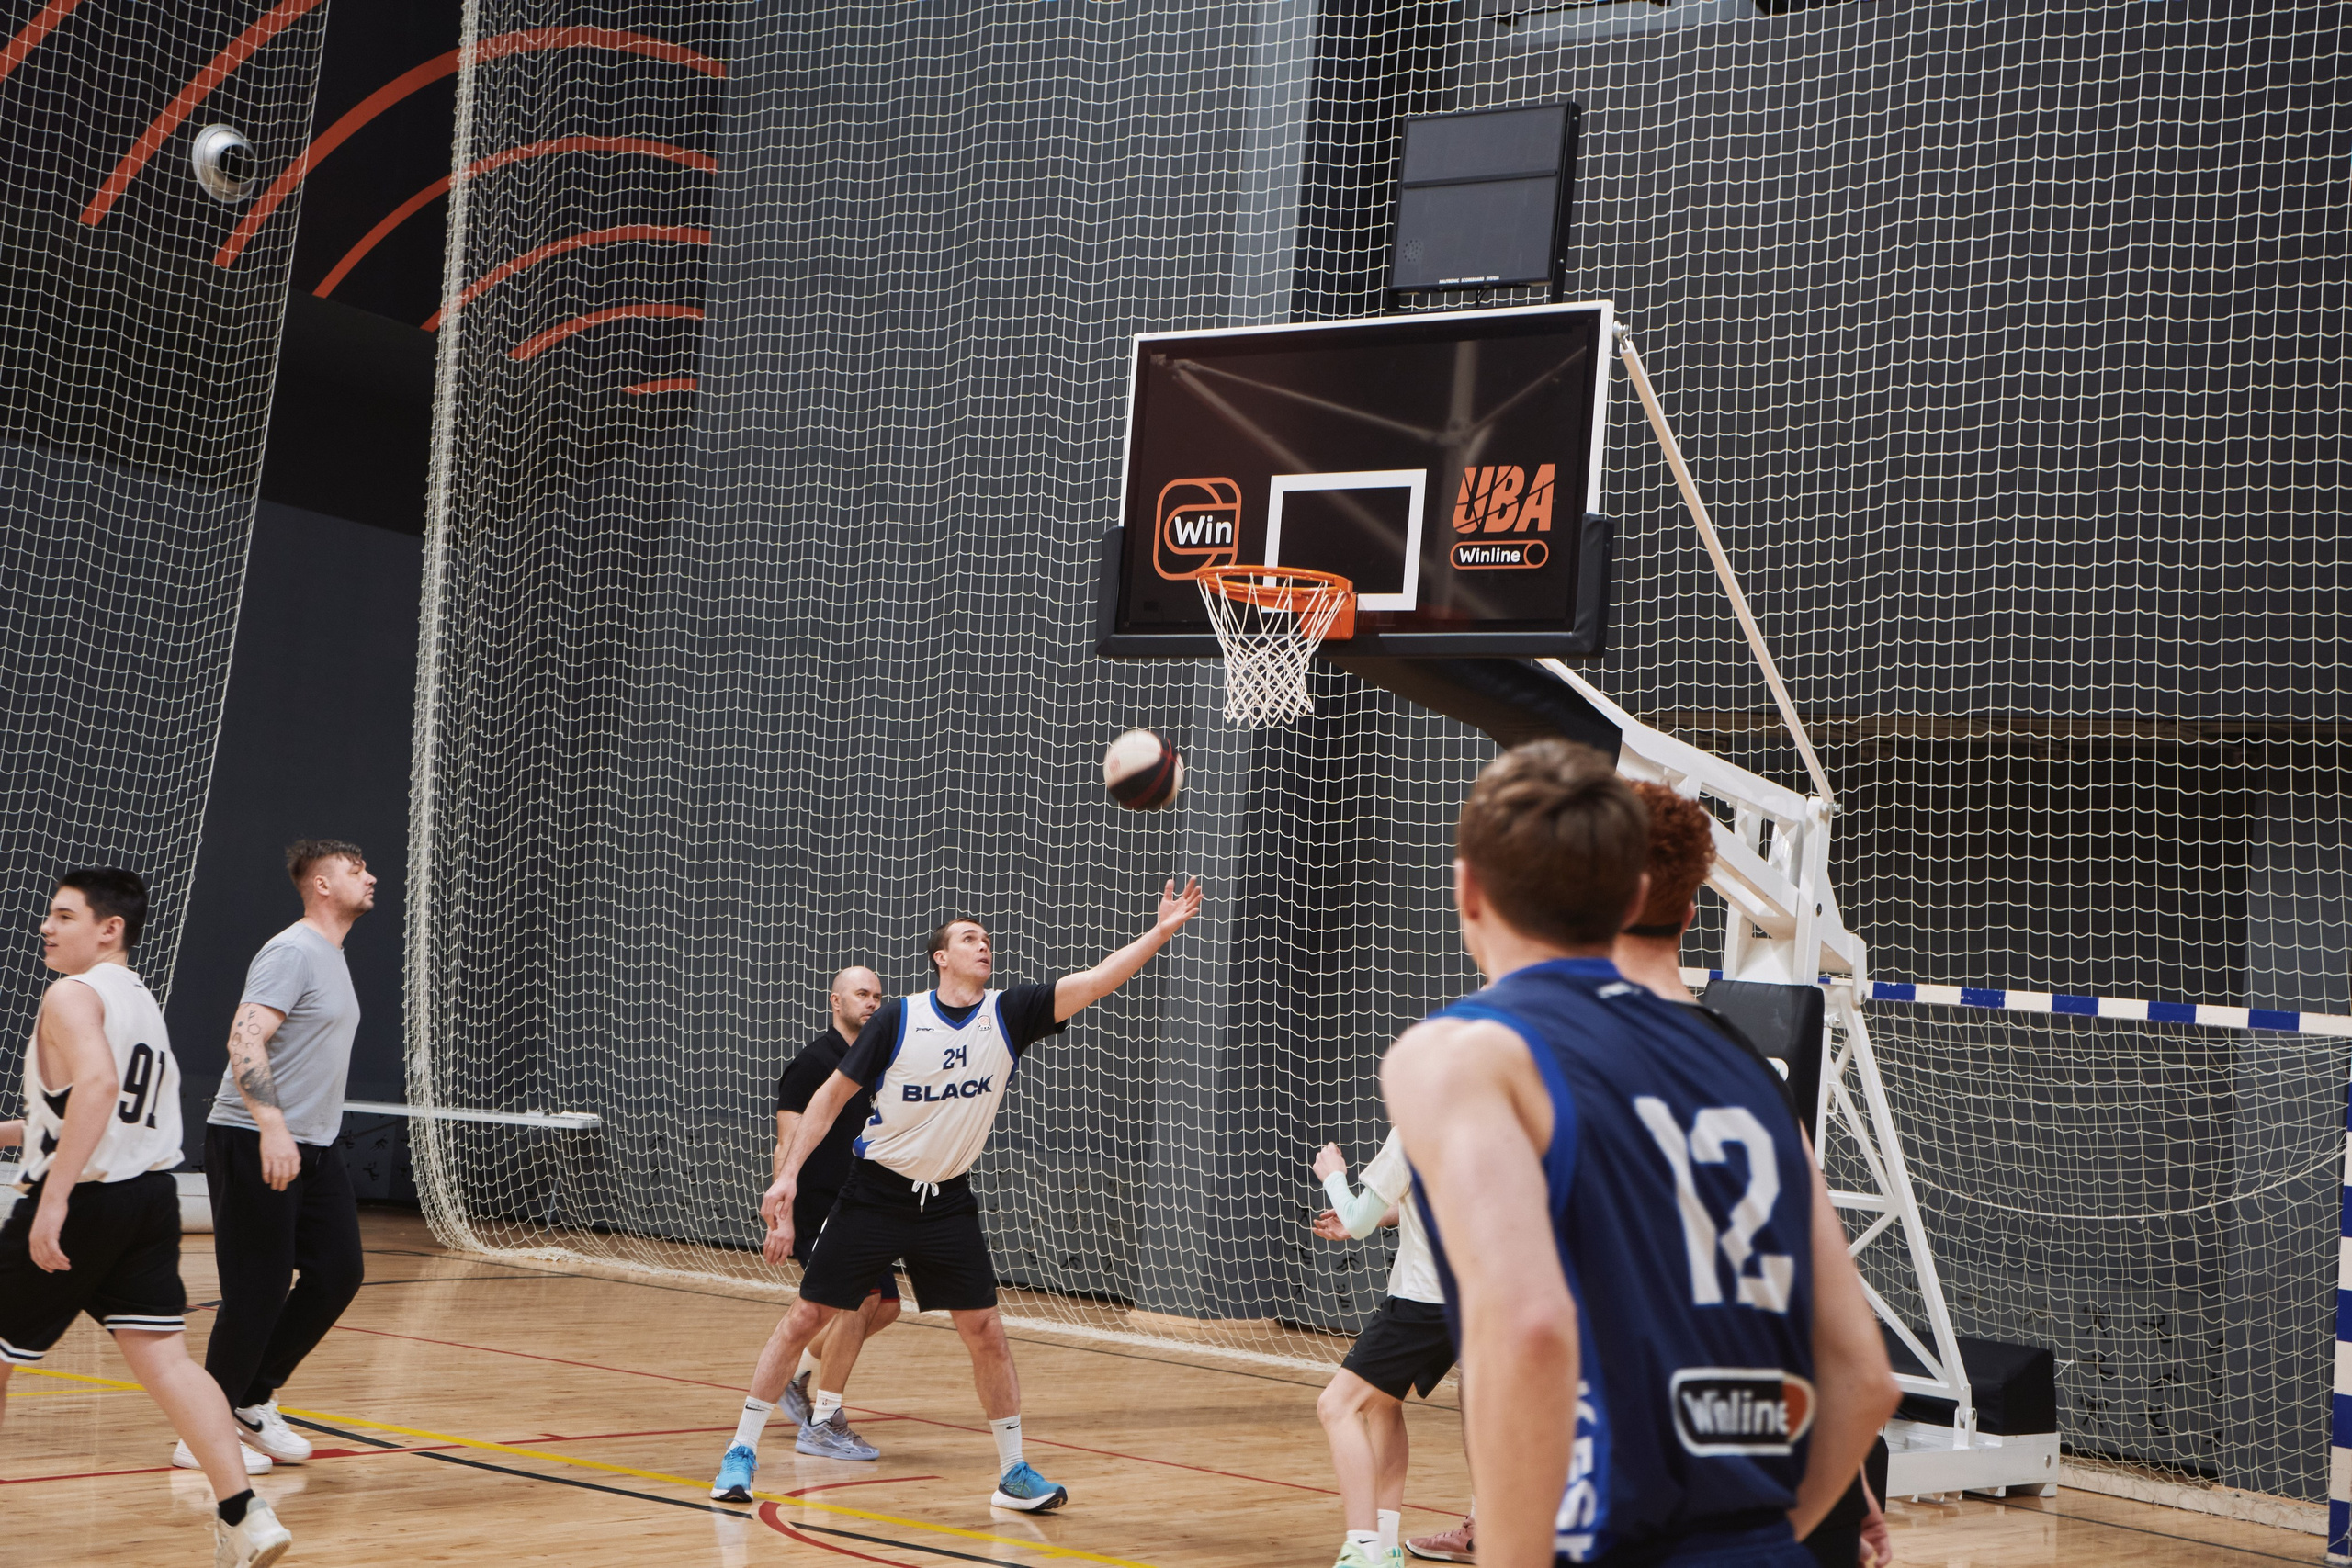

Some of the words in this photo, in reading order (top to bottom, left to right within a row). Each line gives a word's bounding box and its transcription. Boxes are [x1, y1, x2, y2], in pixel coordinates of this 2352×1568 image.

[1453, 463, 1555, 534] UBA
[1174, 515, 1232, 545] Win
[1459, 547, 1521, 563] Winline
[943, 1045, 967, 1070] 24
[119, 1043, 165, 1129] 91
[902, 1074, 993, 1102] BLACK
[1634, 1096, 1795, 1314] 12
